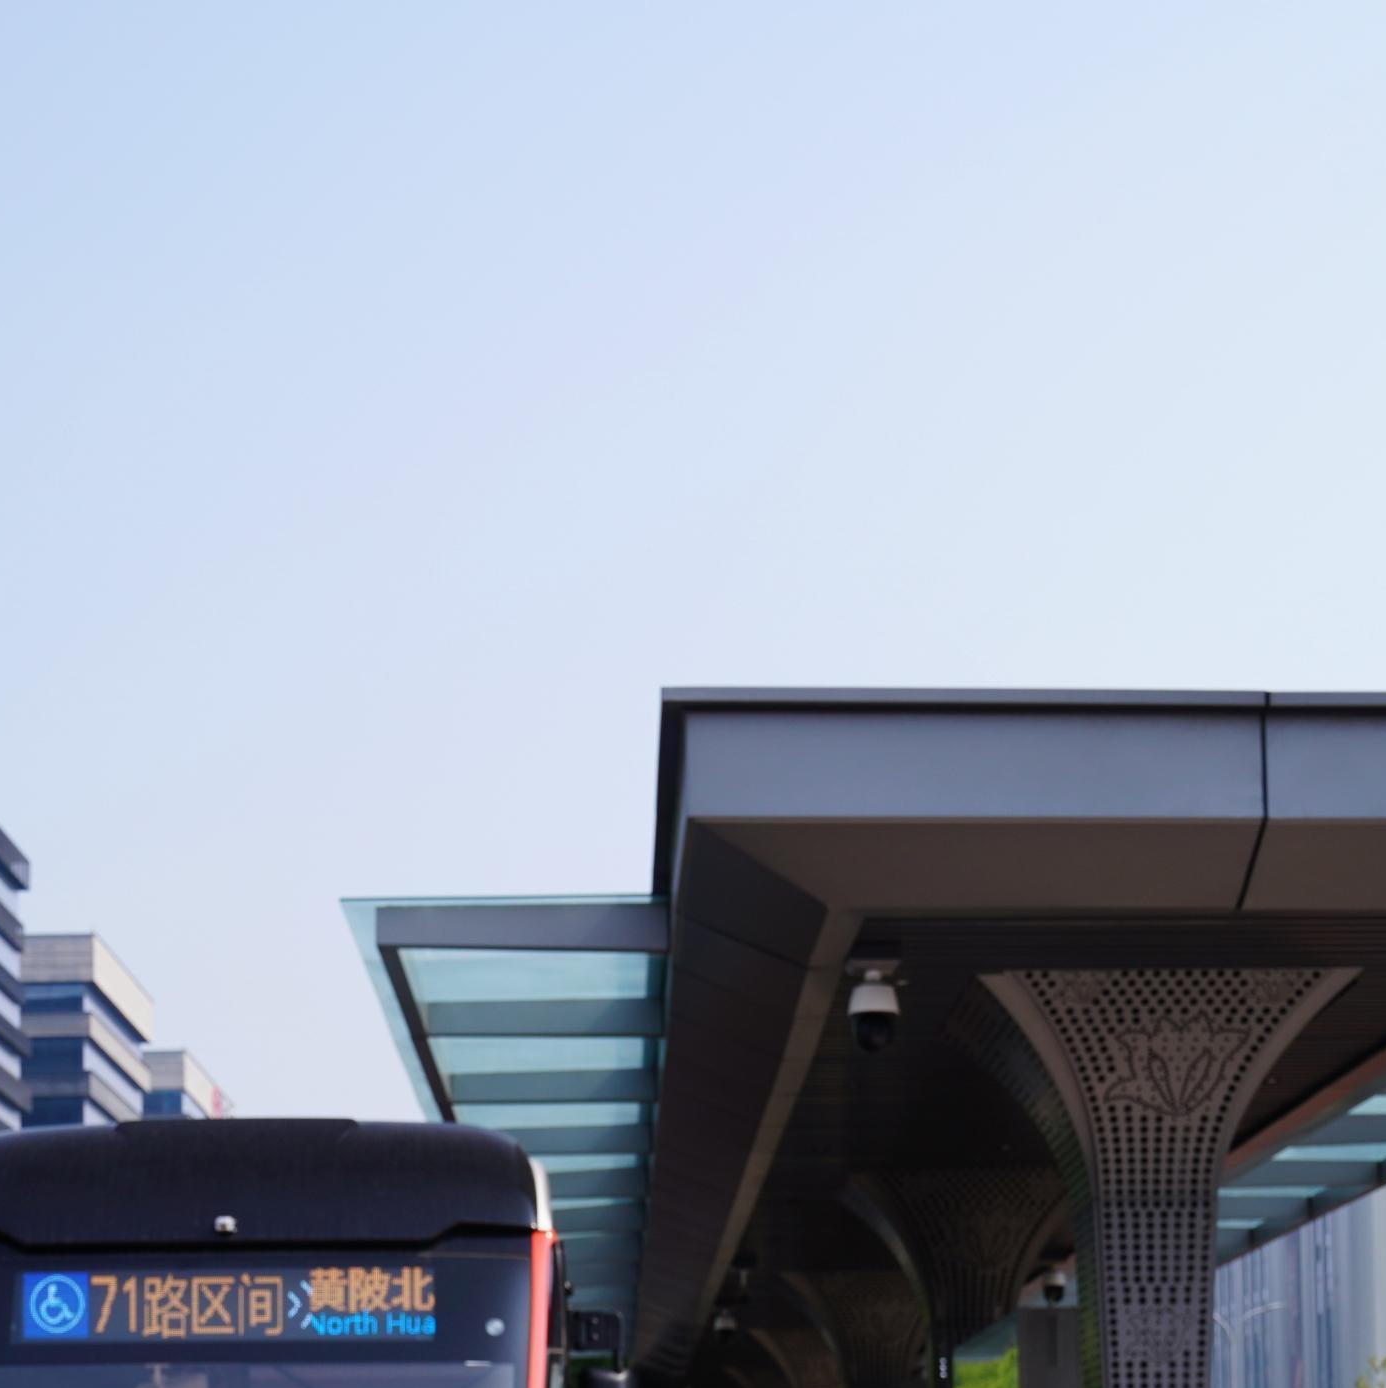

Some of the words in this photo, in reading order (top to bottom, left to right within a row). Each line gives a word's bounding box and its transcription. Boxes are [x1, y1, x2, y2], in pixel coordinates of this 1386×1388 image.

[90, 1274, 284, 1339] 71路区间
[311, 1310, 379, 1336] North
